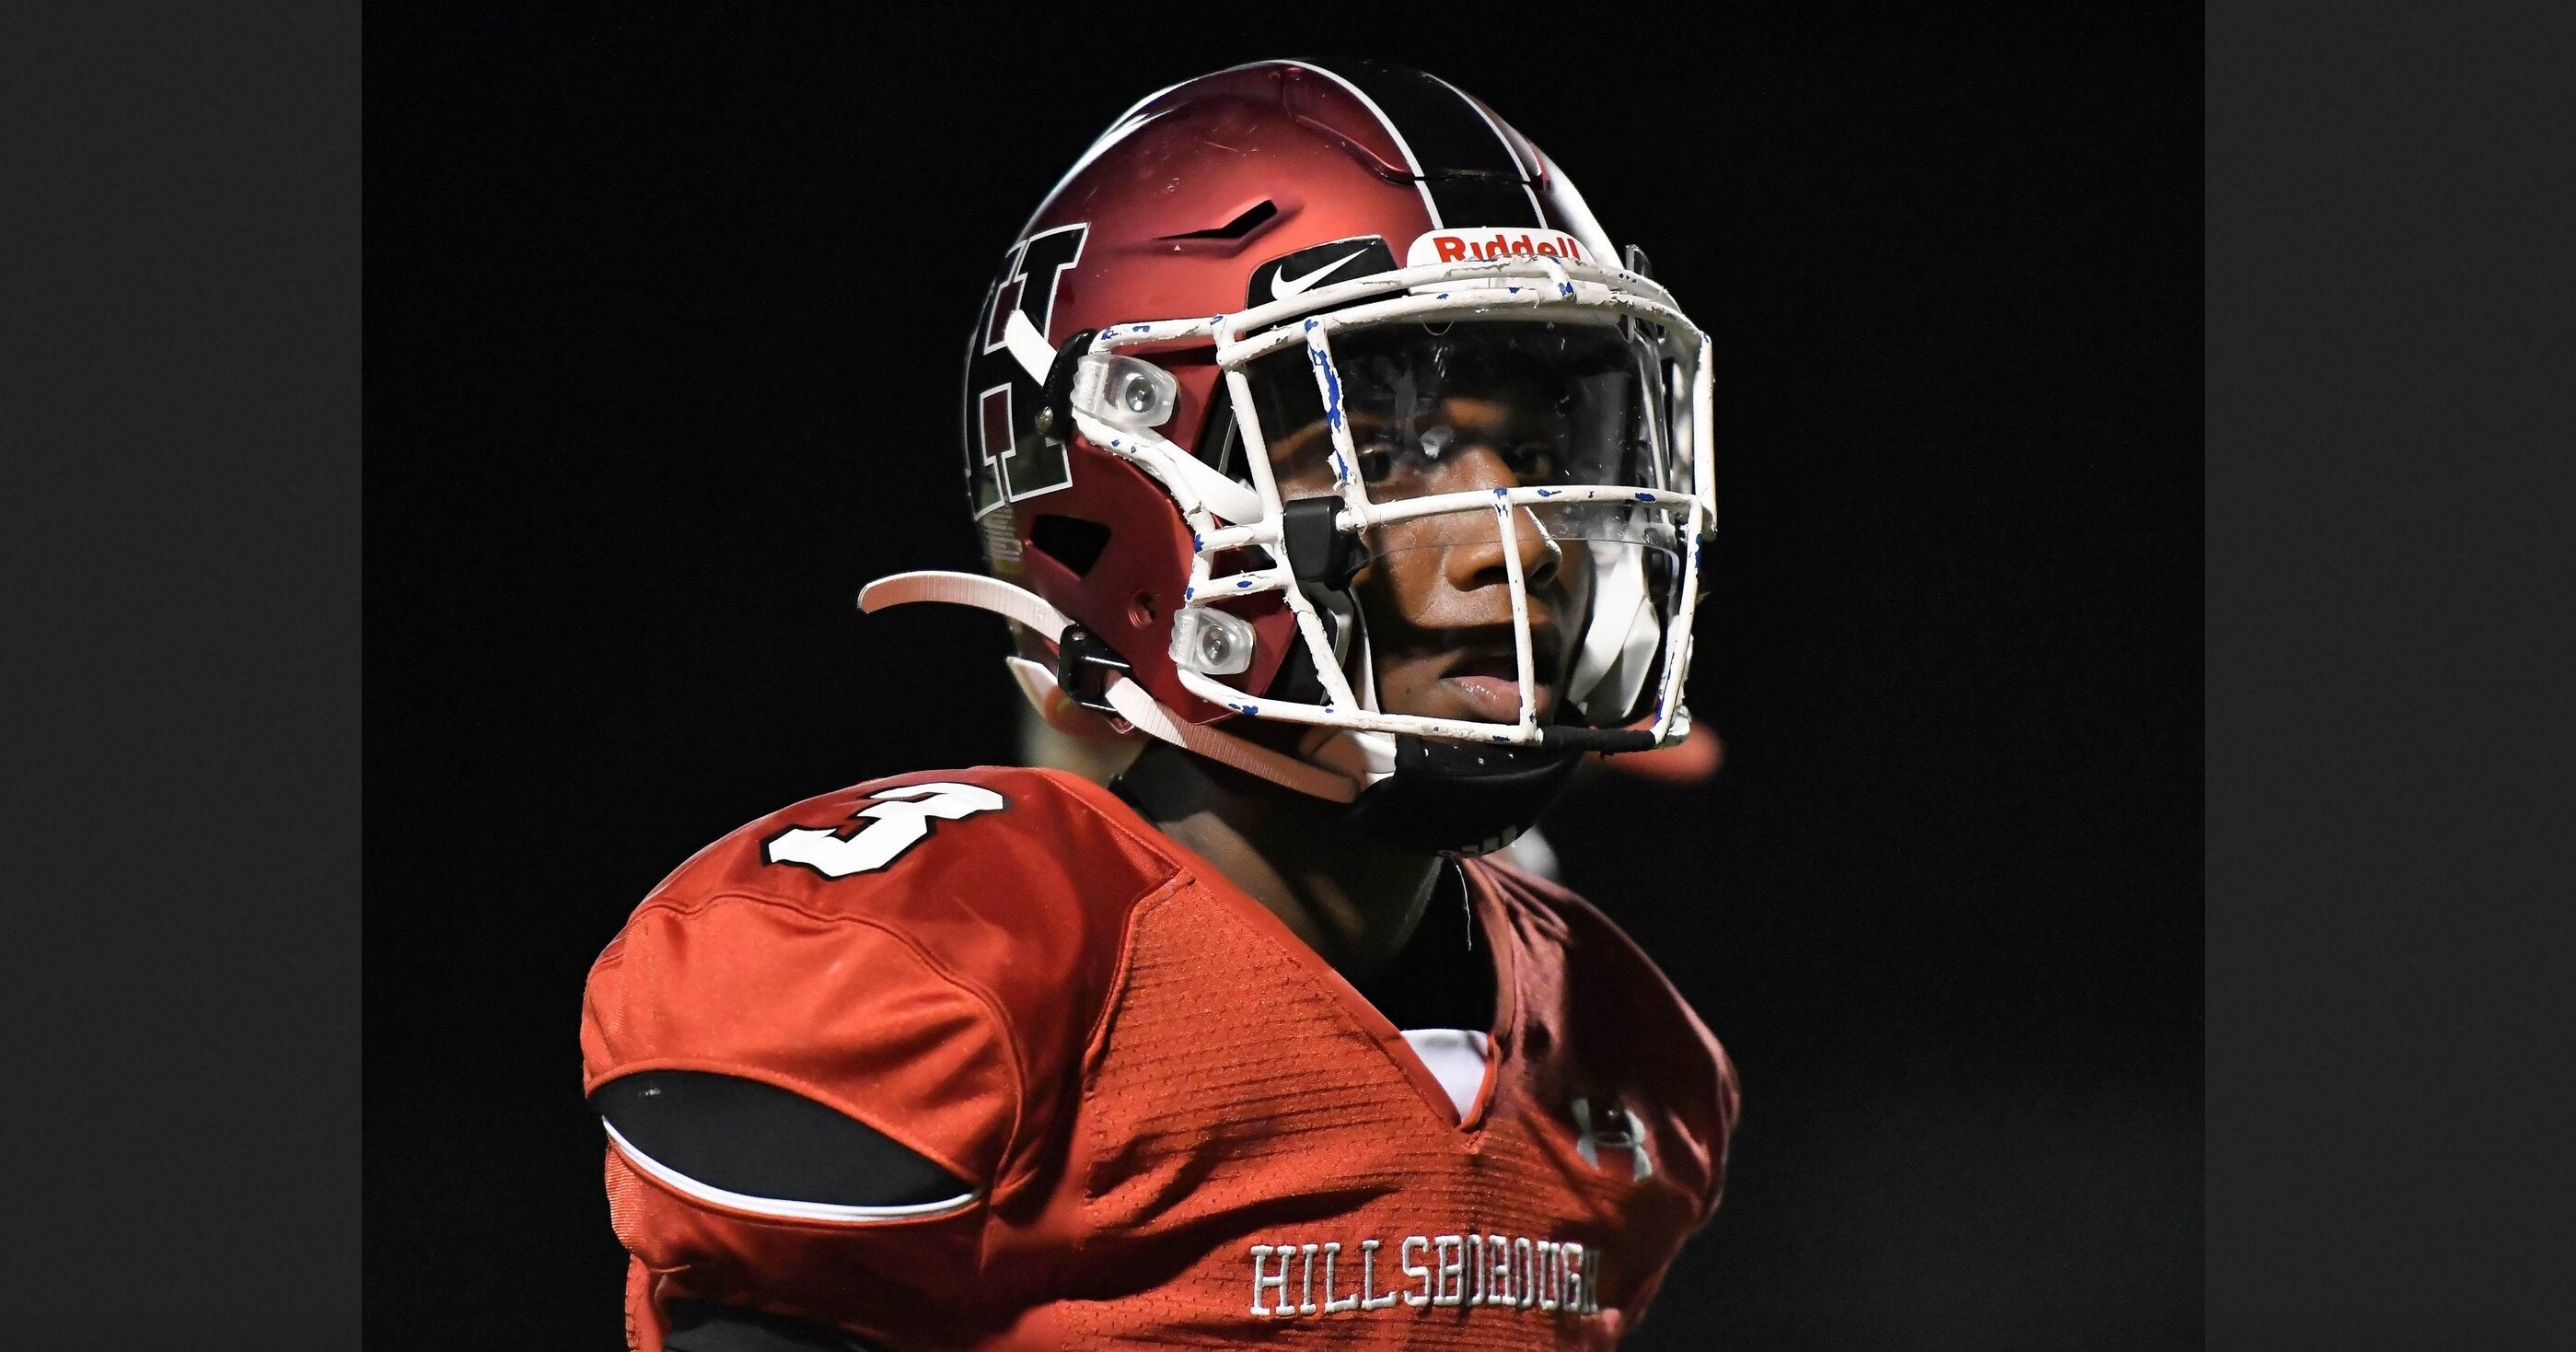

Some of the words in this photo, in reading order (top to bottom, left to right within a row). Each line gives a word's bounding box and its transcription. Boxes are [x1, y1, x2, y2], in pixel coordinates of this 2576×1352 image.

[1433, 234, 1582, 263] Riddell
[760, 782, 1007, 880] 3
[1250, 1234, 1600, 1316] HILLSBOROUGH
